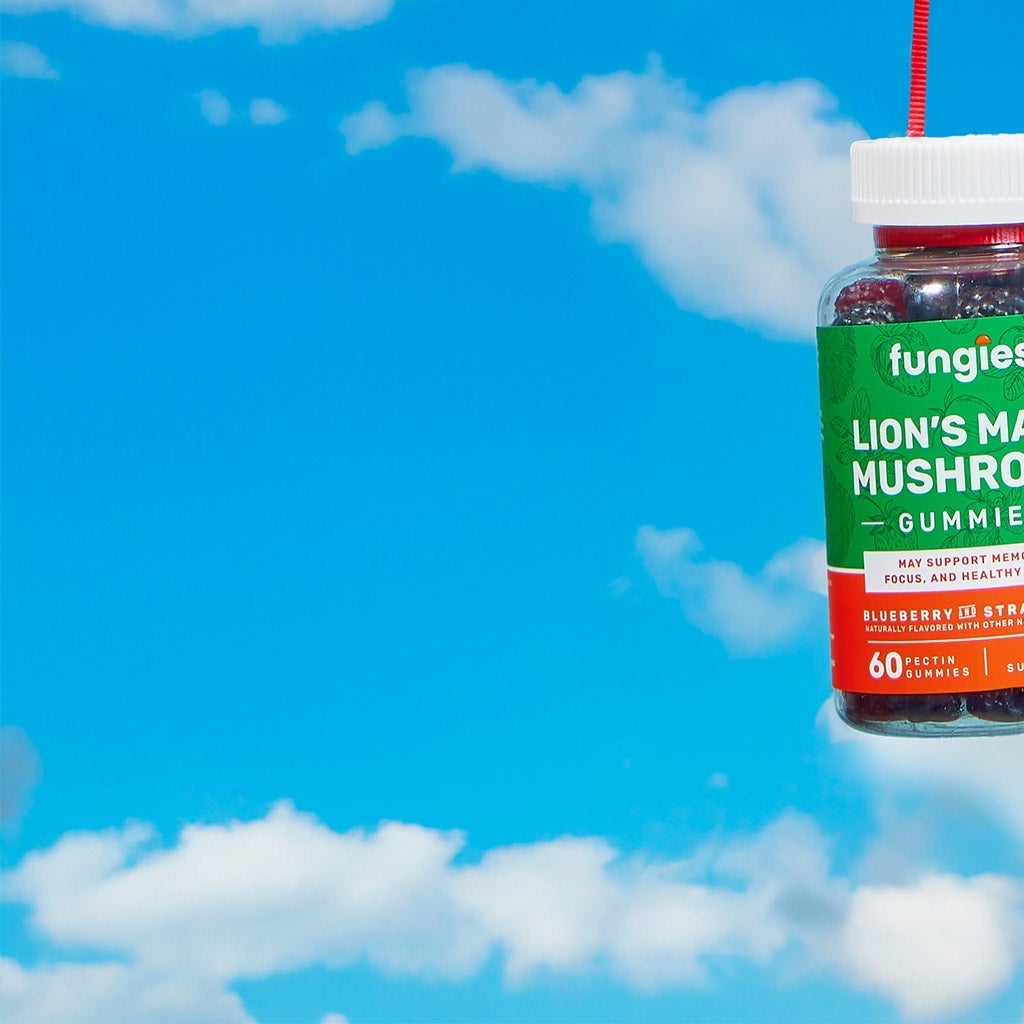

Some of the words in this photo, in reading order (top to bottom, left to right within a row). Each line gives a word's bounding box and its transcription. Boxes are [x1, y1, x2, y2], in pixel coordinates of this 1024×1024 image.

[852, 414, 967, 452] LION'S
[898, 558, 922, 569] MAY
[927, 555, 987, 567] SUPPORT
[884, 574, 927, 584] FOCUS,
[931, 573, 957, 582] AND
[962, 567, 1022, 581] HEALTHY
[864, 608, 953, 622] BLUEBERRY
[958, 605, 977, 618] AND
[909, 622, 954, 632] FLAVORED
[957, 621, 979, 630] WITH
[983, 619, 1014, 628] OTHER
[869, 651, 902, 679] 60
[905, 656, 956, 666] PECTIN
[906, 667, 970, 679] GUMMIES
